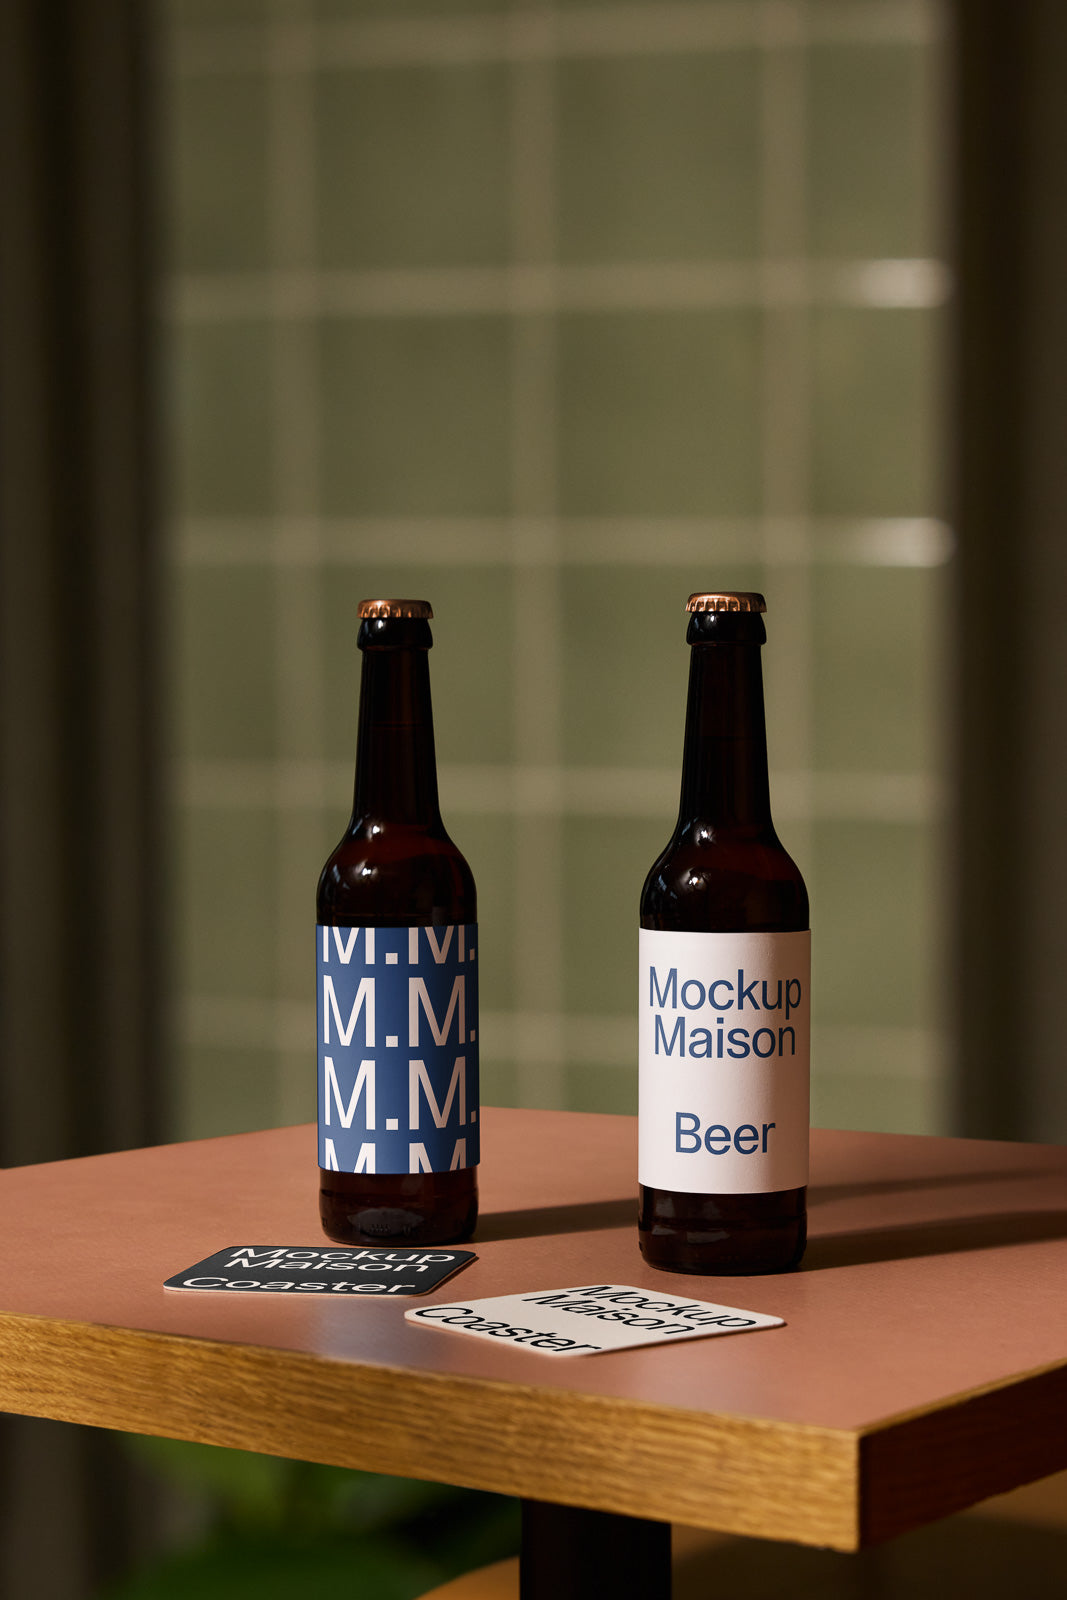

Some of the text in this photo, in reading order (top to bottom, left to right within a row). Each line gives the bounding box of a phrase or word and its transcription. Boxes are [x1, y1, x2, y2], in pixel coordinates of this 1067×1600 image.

[649, 966, 801, 1020] Mockup
[654, 1014, 796, 1059] Maison
[675, 1111, 776, 1155] Beer
[224, 1257, 430, 1272] Maison
[230, 1248, 455, 1264] Mockup
[182, 1277, 416, 1293] Coaster
[566, 1285, 757, 1329] Mockup
[414, 1307, 602, 1352] Coaster
[522, 1294, 696, 1335] Maison
